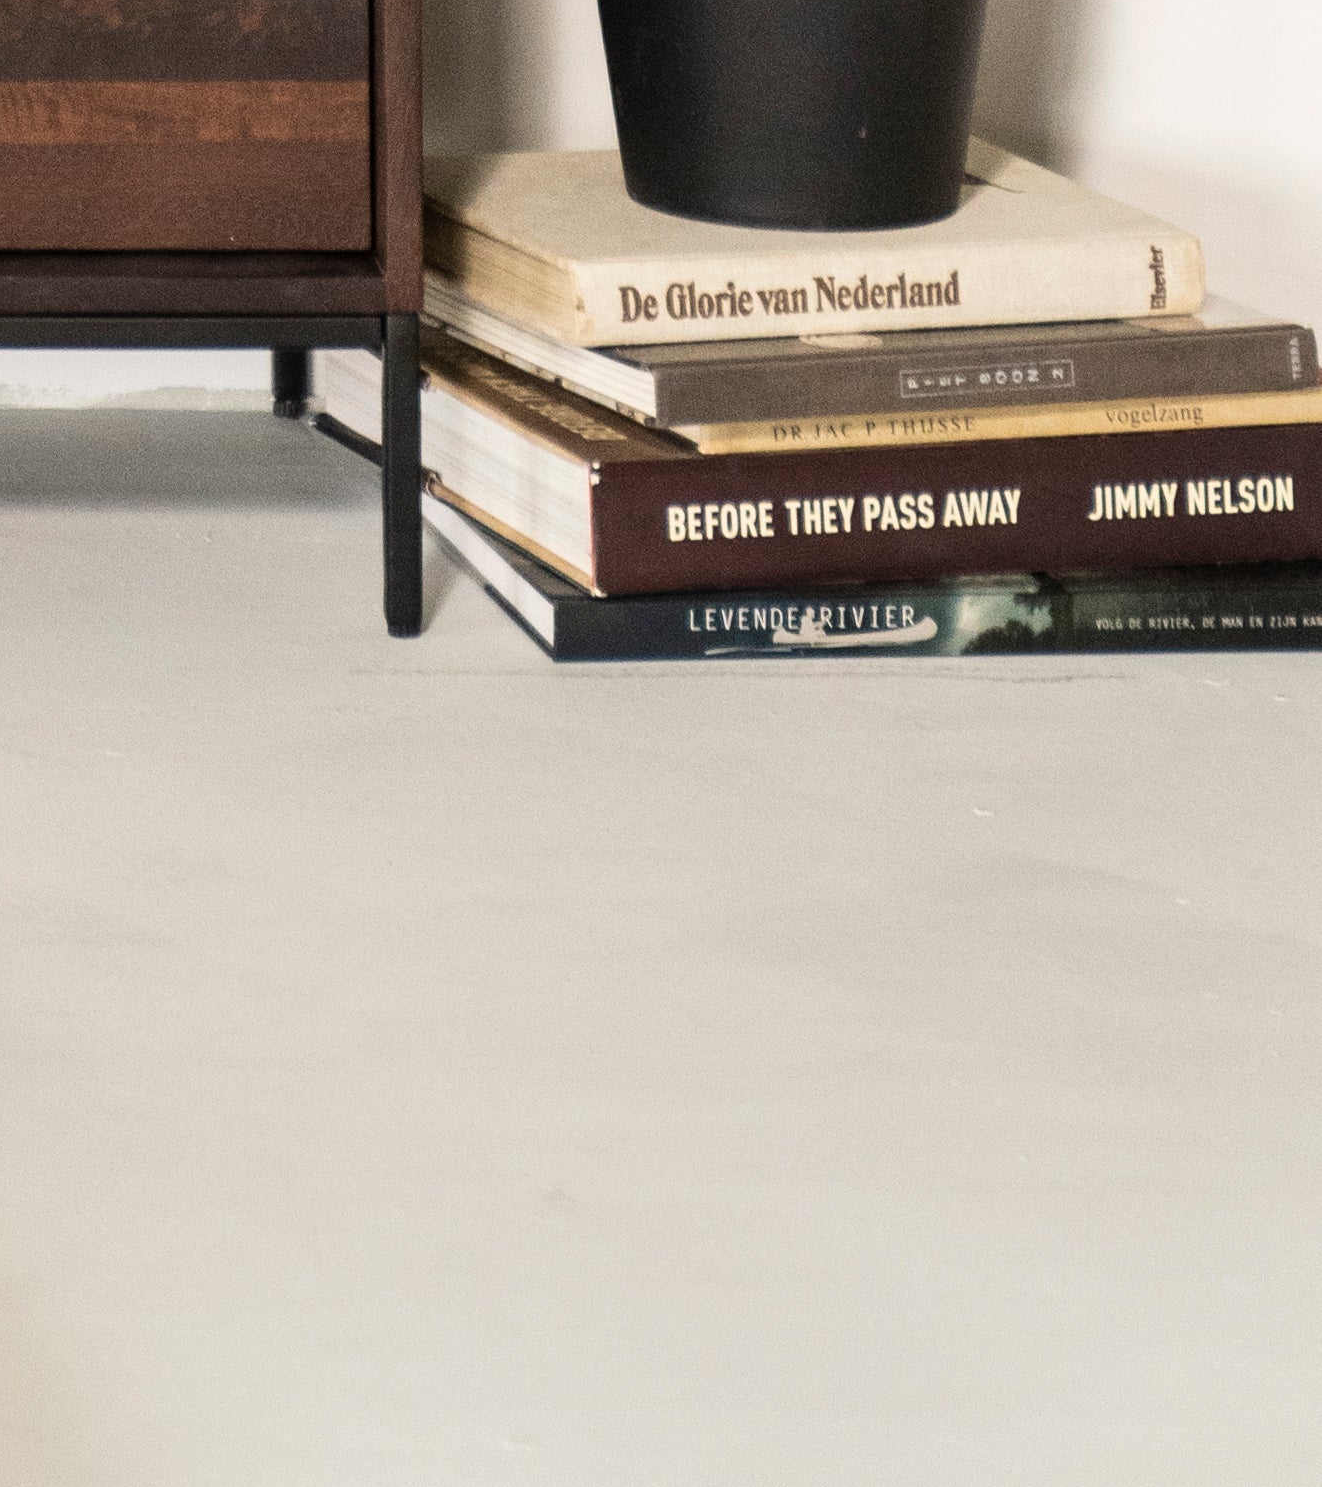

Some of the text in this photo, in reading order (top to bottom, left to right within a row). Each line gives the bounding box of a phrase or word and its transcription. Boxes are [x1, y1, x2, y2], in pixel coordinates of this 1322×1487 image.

[619, 269, 962, 323] De Glorie van Nederland
[1150, 245, 1167, 310] Elsevier
[1105, 403, 1204, 428] vogelzang
[667, 488, 1022, 542] BEFORE THEY PASS AWAY
[1087, 476, 1295, 521] JIMMY NELSON
